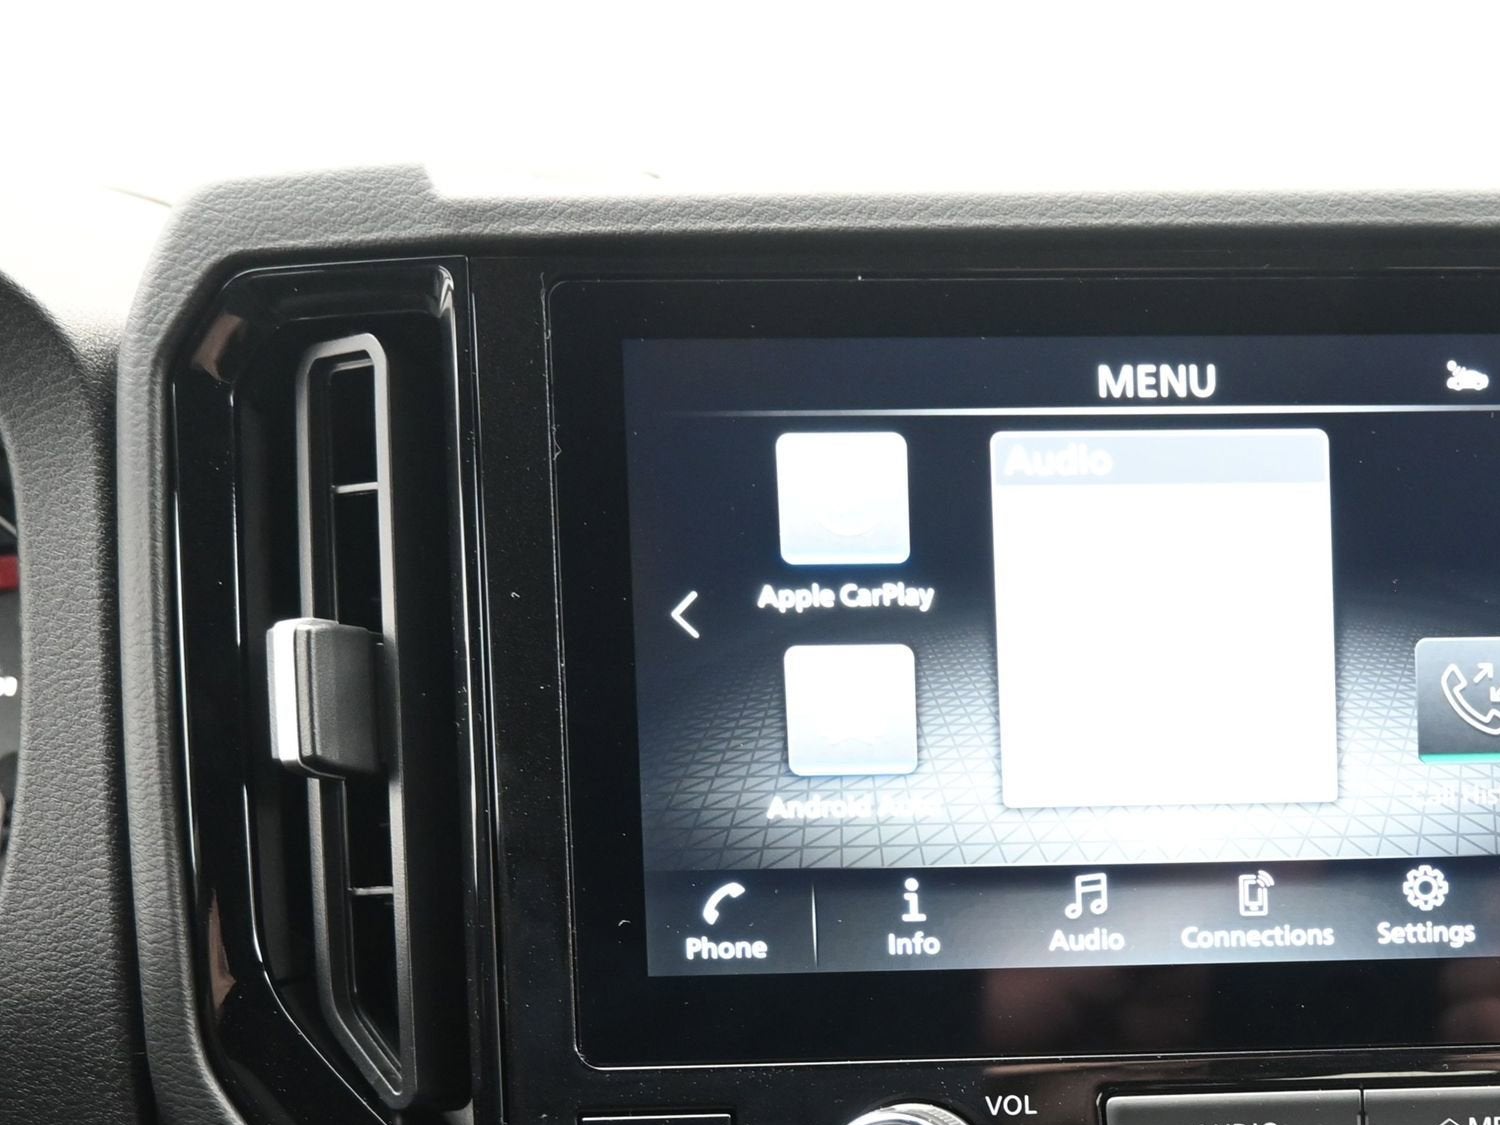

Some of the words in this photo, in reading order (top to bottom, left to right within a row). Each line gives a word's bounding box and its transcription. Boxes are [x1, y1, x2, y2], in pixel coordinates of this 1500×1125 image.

[1097, 363, 1217, 399] MENU
[1004, 442, 1114, 477] Audio
[756, 582, 837, 614] Apple
[838, 581, 936, 613] CarPlay
[766, 794, 871, 820] Android
[685, 935, 768, 961] Phone
[887, 930, 942, 956] Info
[1048, 926, 1126, 952] Audio
[1180, 922, 1335, 950] Connections
[1376, 920, 1477, 949] Settings
[984, 1094, 1038, 1116] VOL
